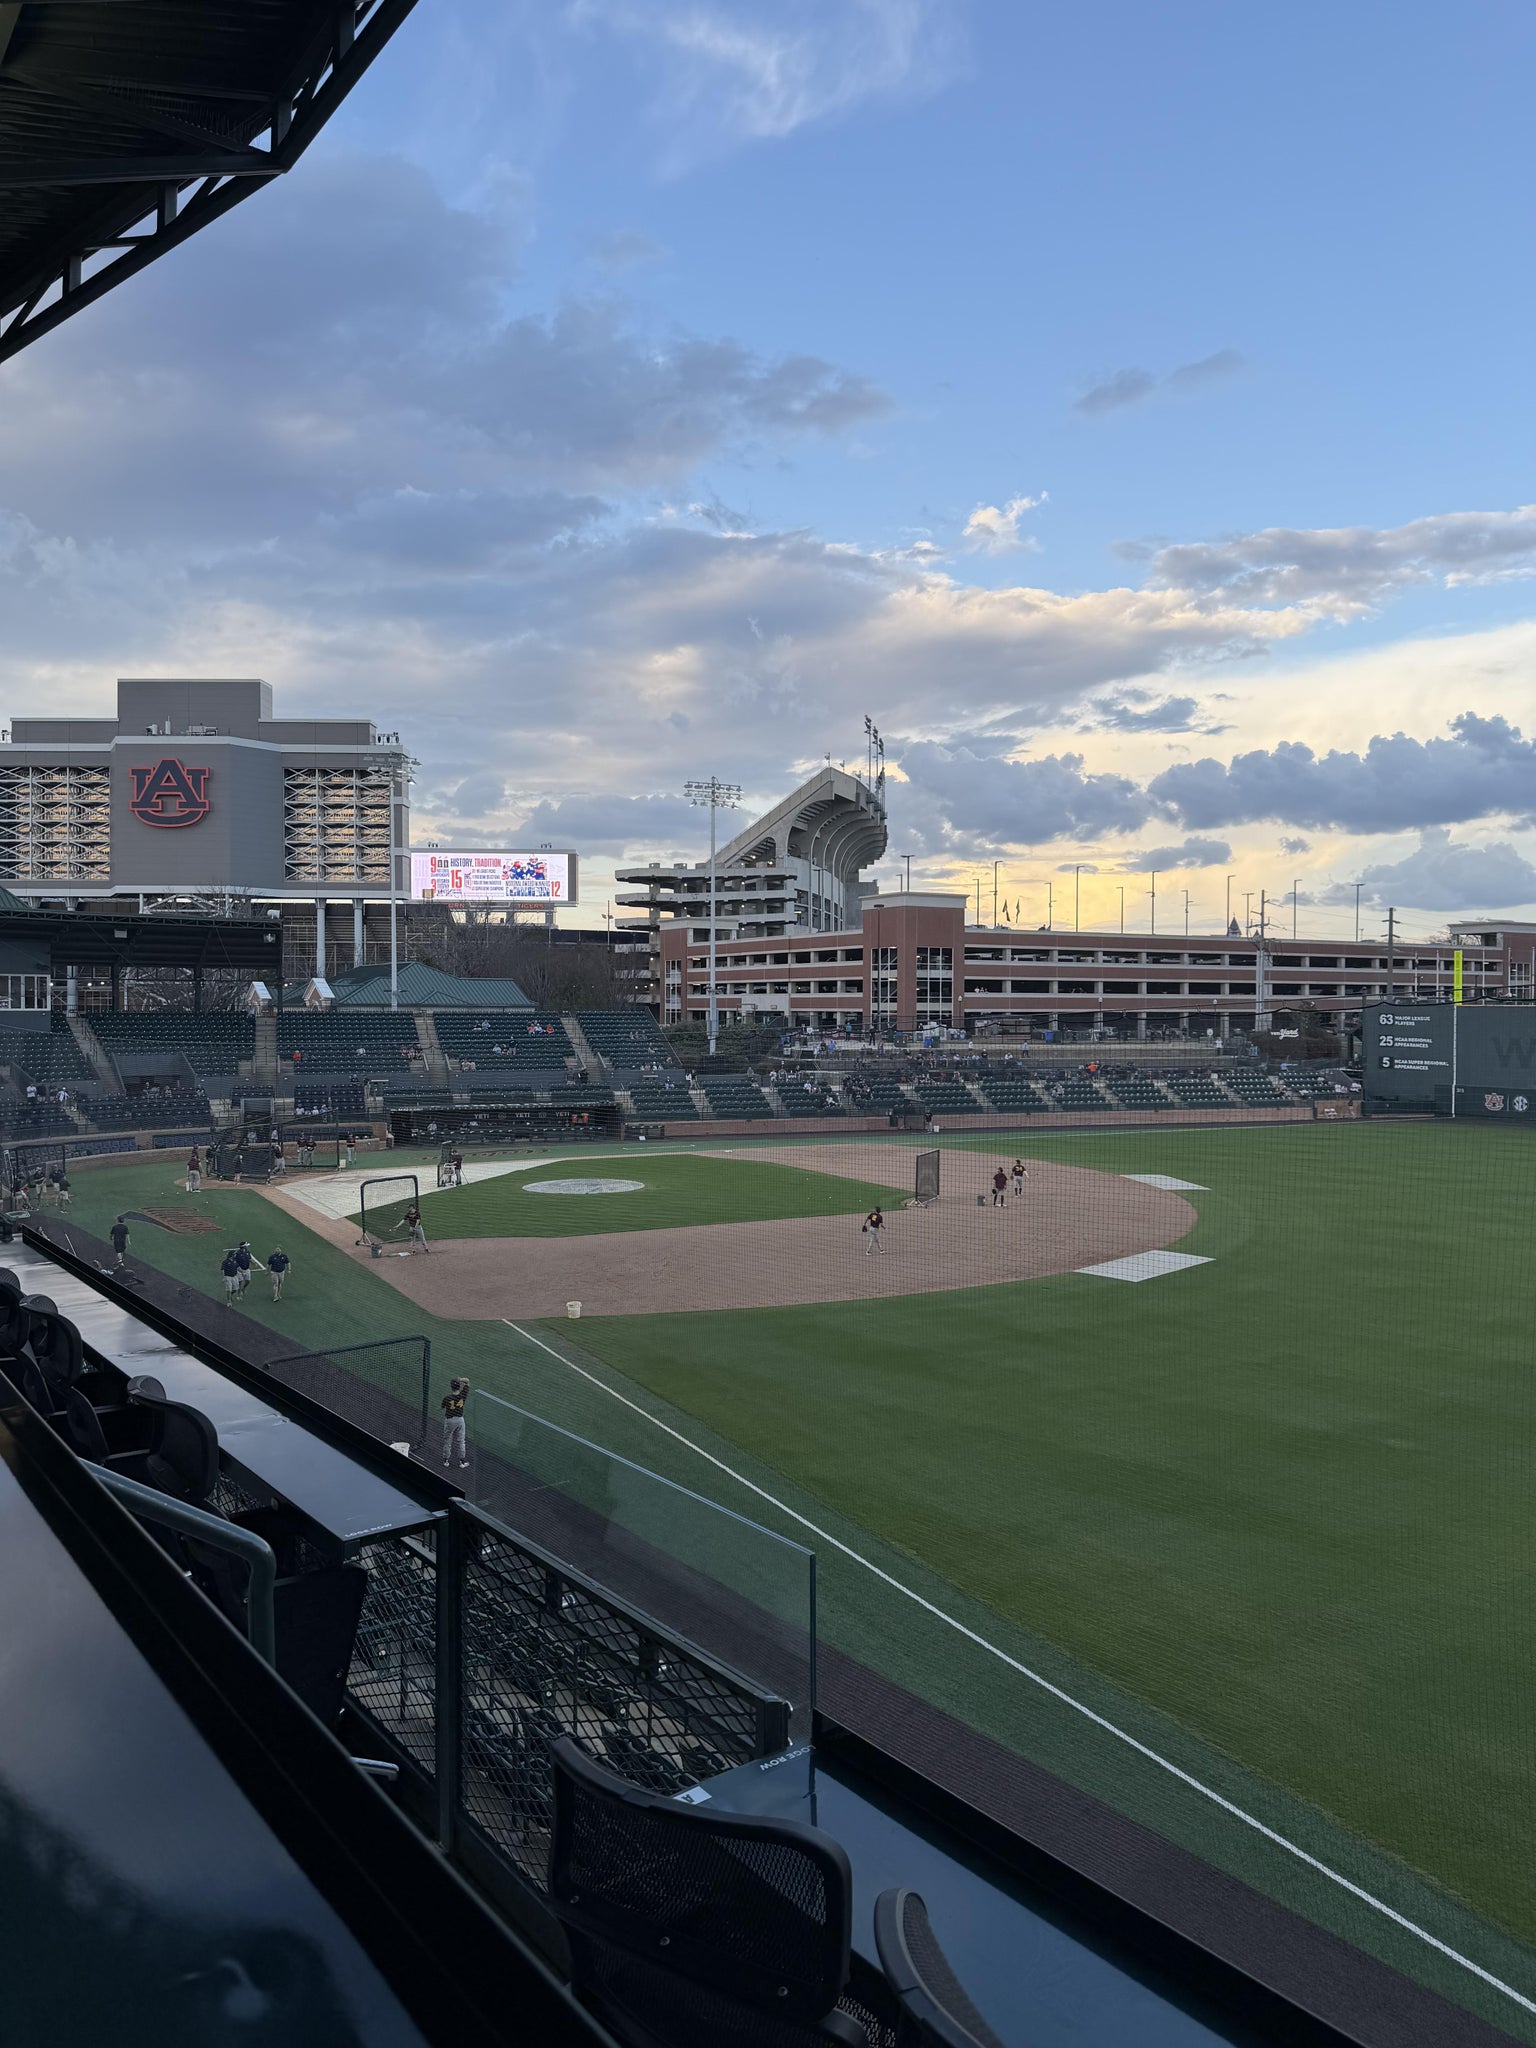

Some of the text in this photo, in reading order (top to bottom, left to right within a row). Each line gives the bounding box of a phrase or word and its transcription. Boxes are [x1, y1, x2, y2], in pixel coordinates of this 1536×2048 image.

[430, 857, 437, 873] 9
[450, 858, 503, 867] HISTORY. TRADITION.
[450, 869, 462, 888] 15
[430, 879, 437, 894] 3
[551, 881, 561, 897] 12
[1379, 1014, 1394, 1025] 63
[1379, 1035, 1393, 1047] 25
[1382, 1057, 1390, 1068] 5
[449, 1399, 464, 1410] 14
[760, 1744, 817, 1771] LOGE ROW
